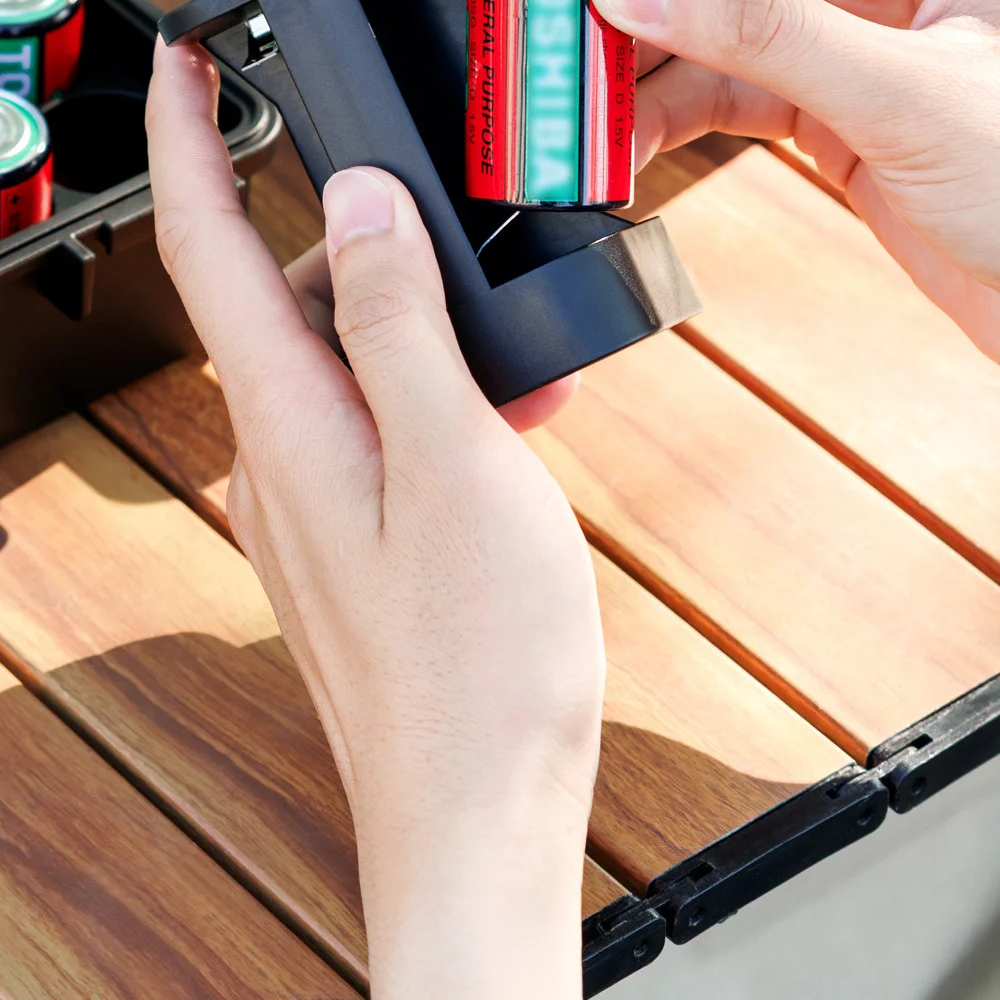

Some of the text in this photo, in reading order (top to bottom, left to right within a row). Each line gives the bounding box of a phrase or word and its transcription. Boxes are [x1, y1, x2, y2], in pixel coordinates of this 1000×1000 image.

[481, 65, 495, 177] PURPOSE
[614, 46, 625, 148] SIZE D 1.5V
